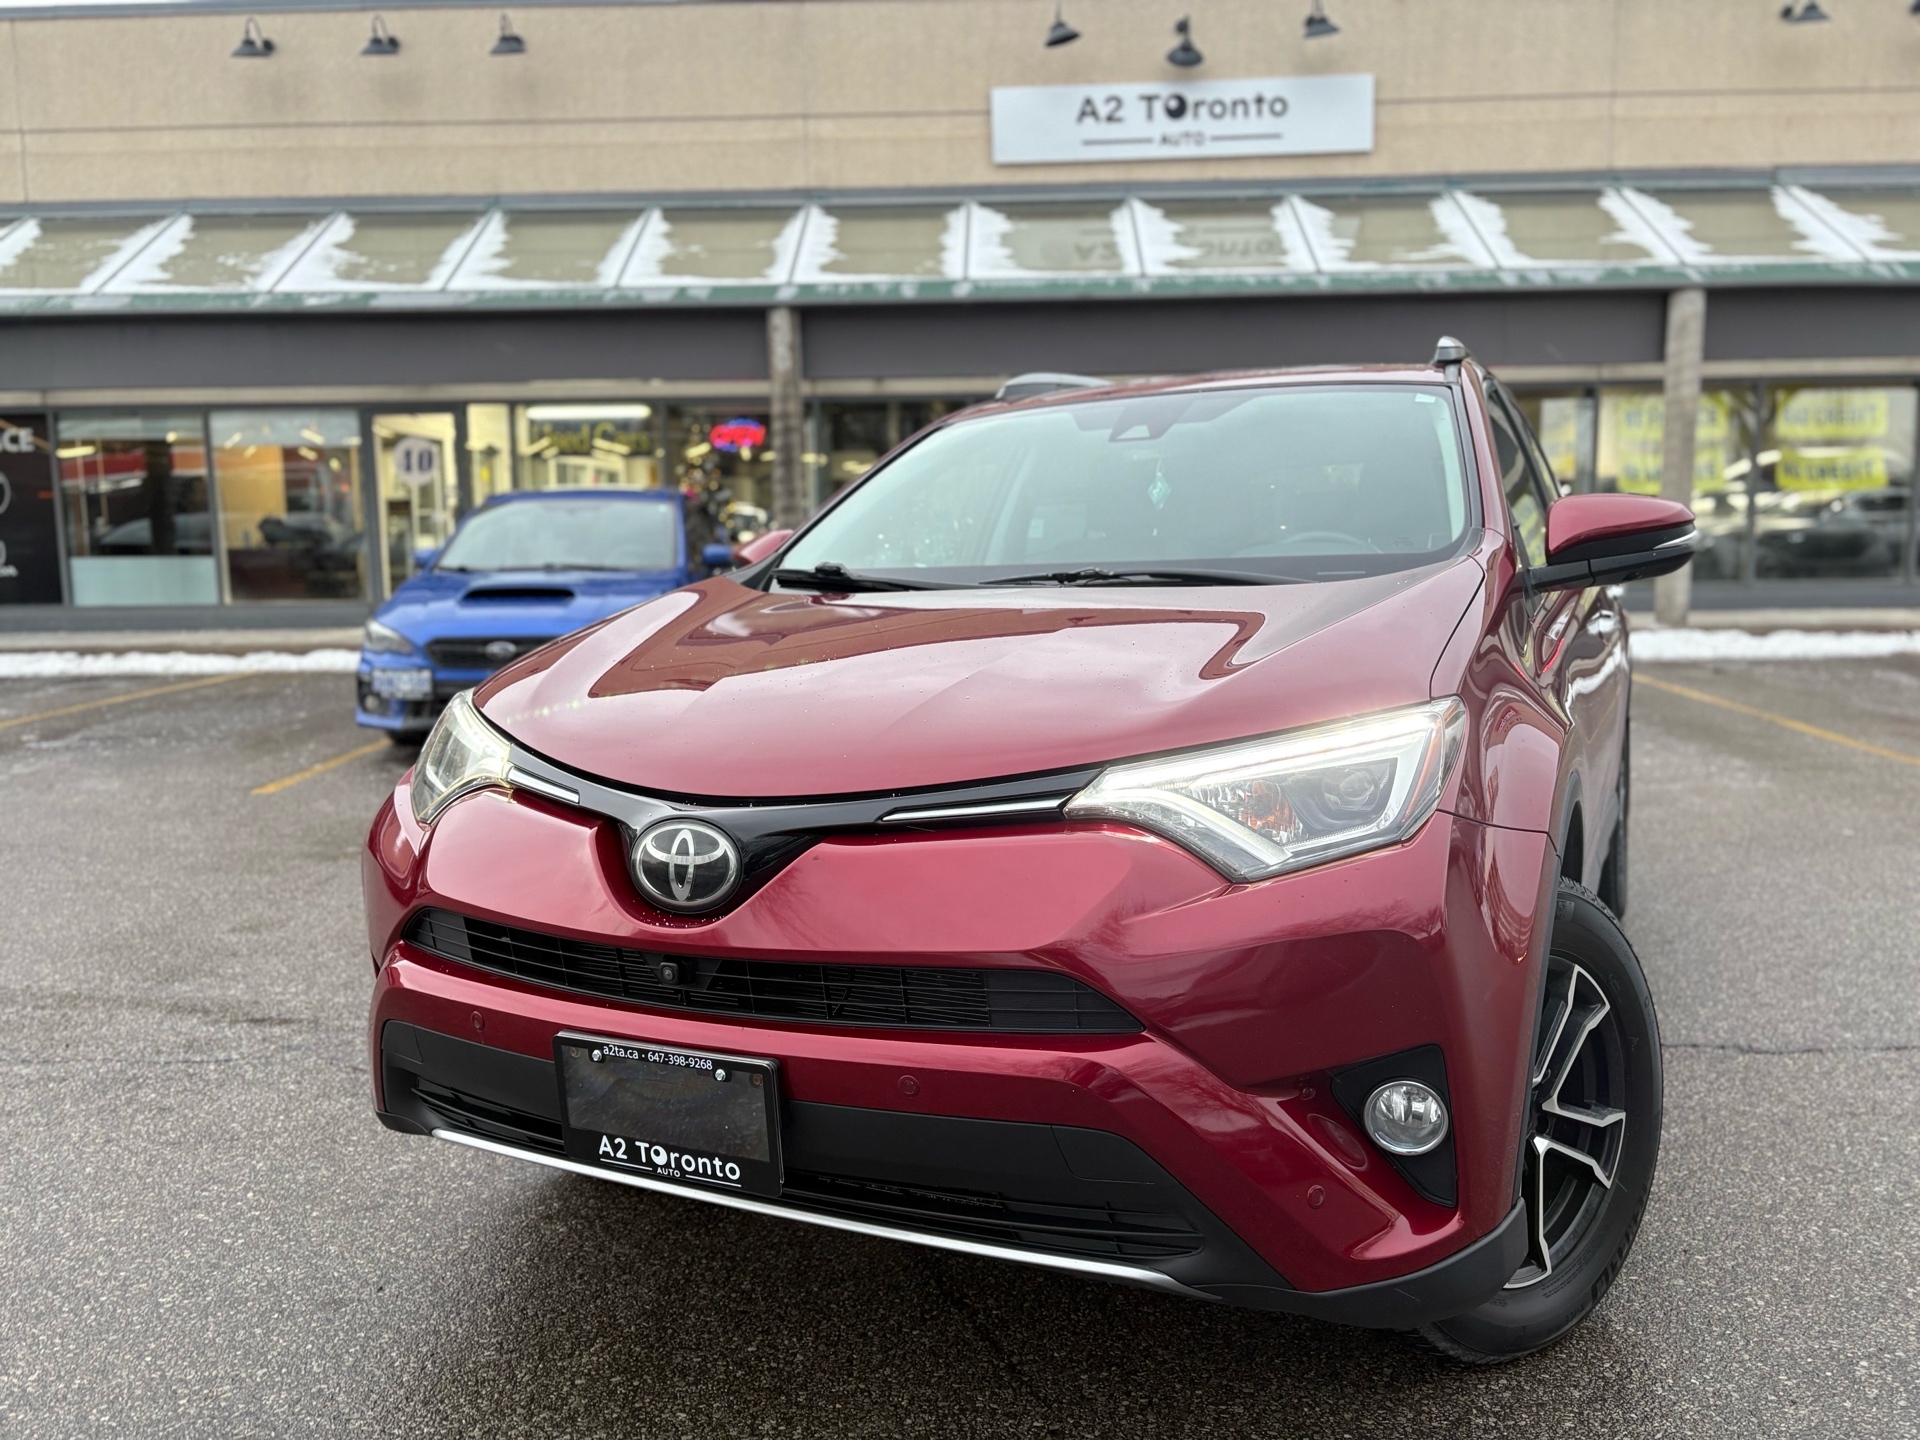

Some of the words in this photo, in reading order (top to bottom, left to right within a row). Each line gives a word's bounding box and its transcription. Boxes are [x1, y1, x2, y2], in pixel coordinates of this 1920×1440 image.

[1075, 94, 1124, 125] A2
[1159, 131, 1206, 146] AUTO
[403, 448, 433, 474] 10
[603, 1045, 639, 1060] a2ta.ca
[647, 1051, 713, 1071] 647-398-9268
[598, 1134, 628, 1160] A2
[656, 1166, 681, 1178] AUTO
